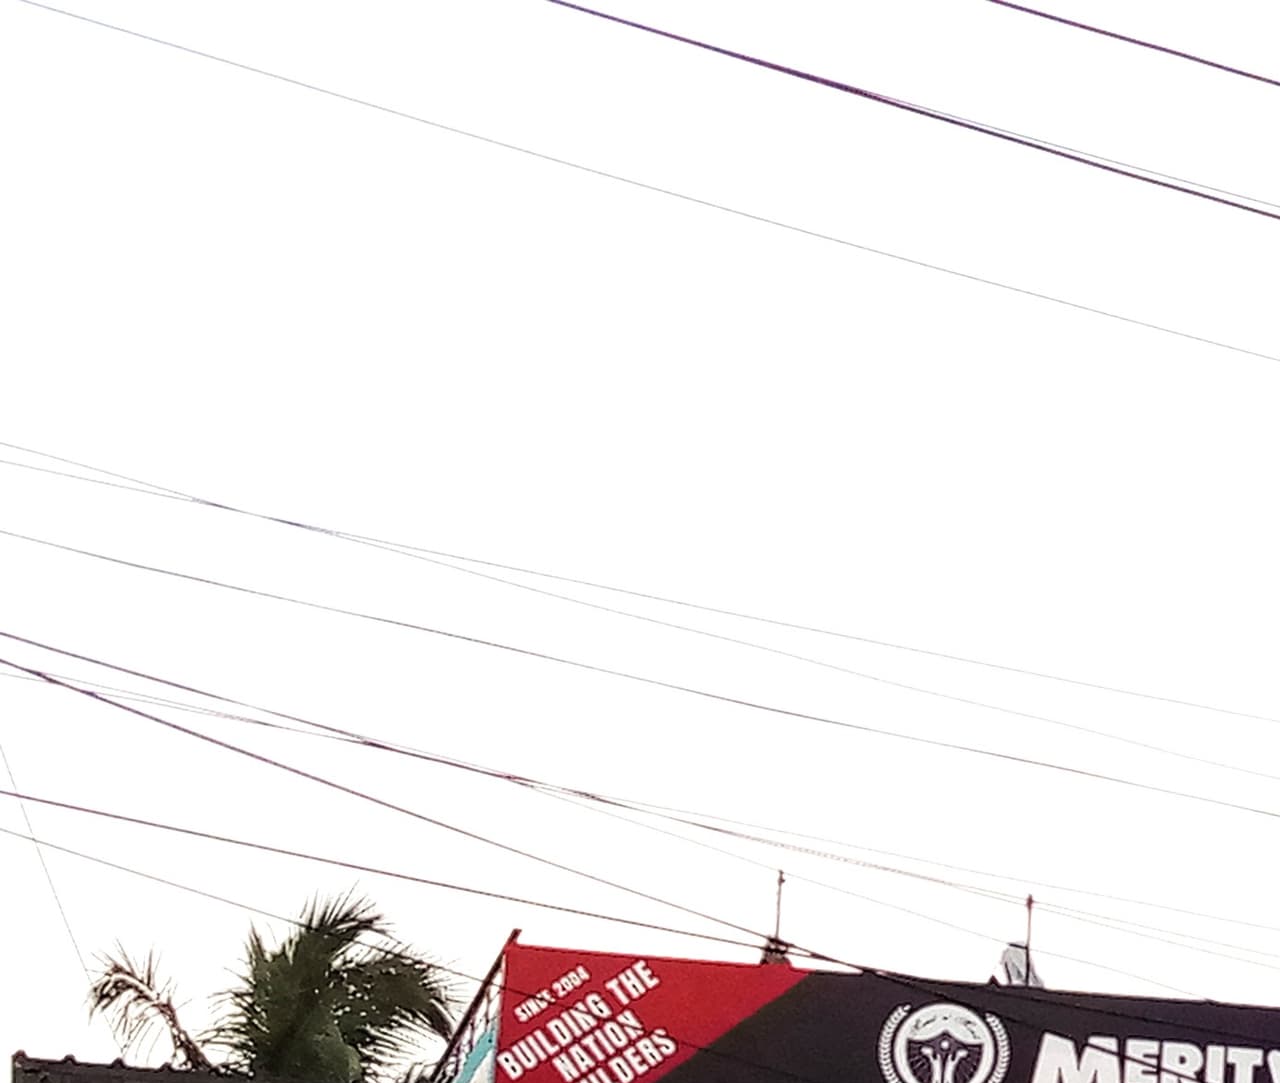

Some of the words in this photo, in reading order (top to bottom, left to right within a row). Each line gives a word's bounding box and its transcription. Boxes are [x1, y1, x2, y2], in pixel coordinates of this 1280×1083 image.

[497, 993, 612, 1080] BUILDING
[605, 960, 660, 1005] THE
[514, 988, 556, 1022] SINCE
[552, 965, 590, 997] 2004
[552, 1010, 644, 1082] NATION
